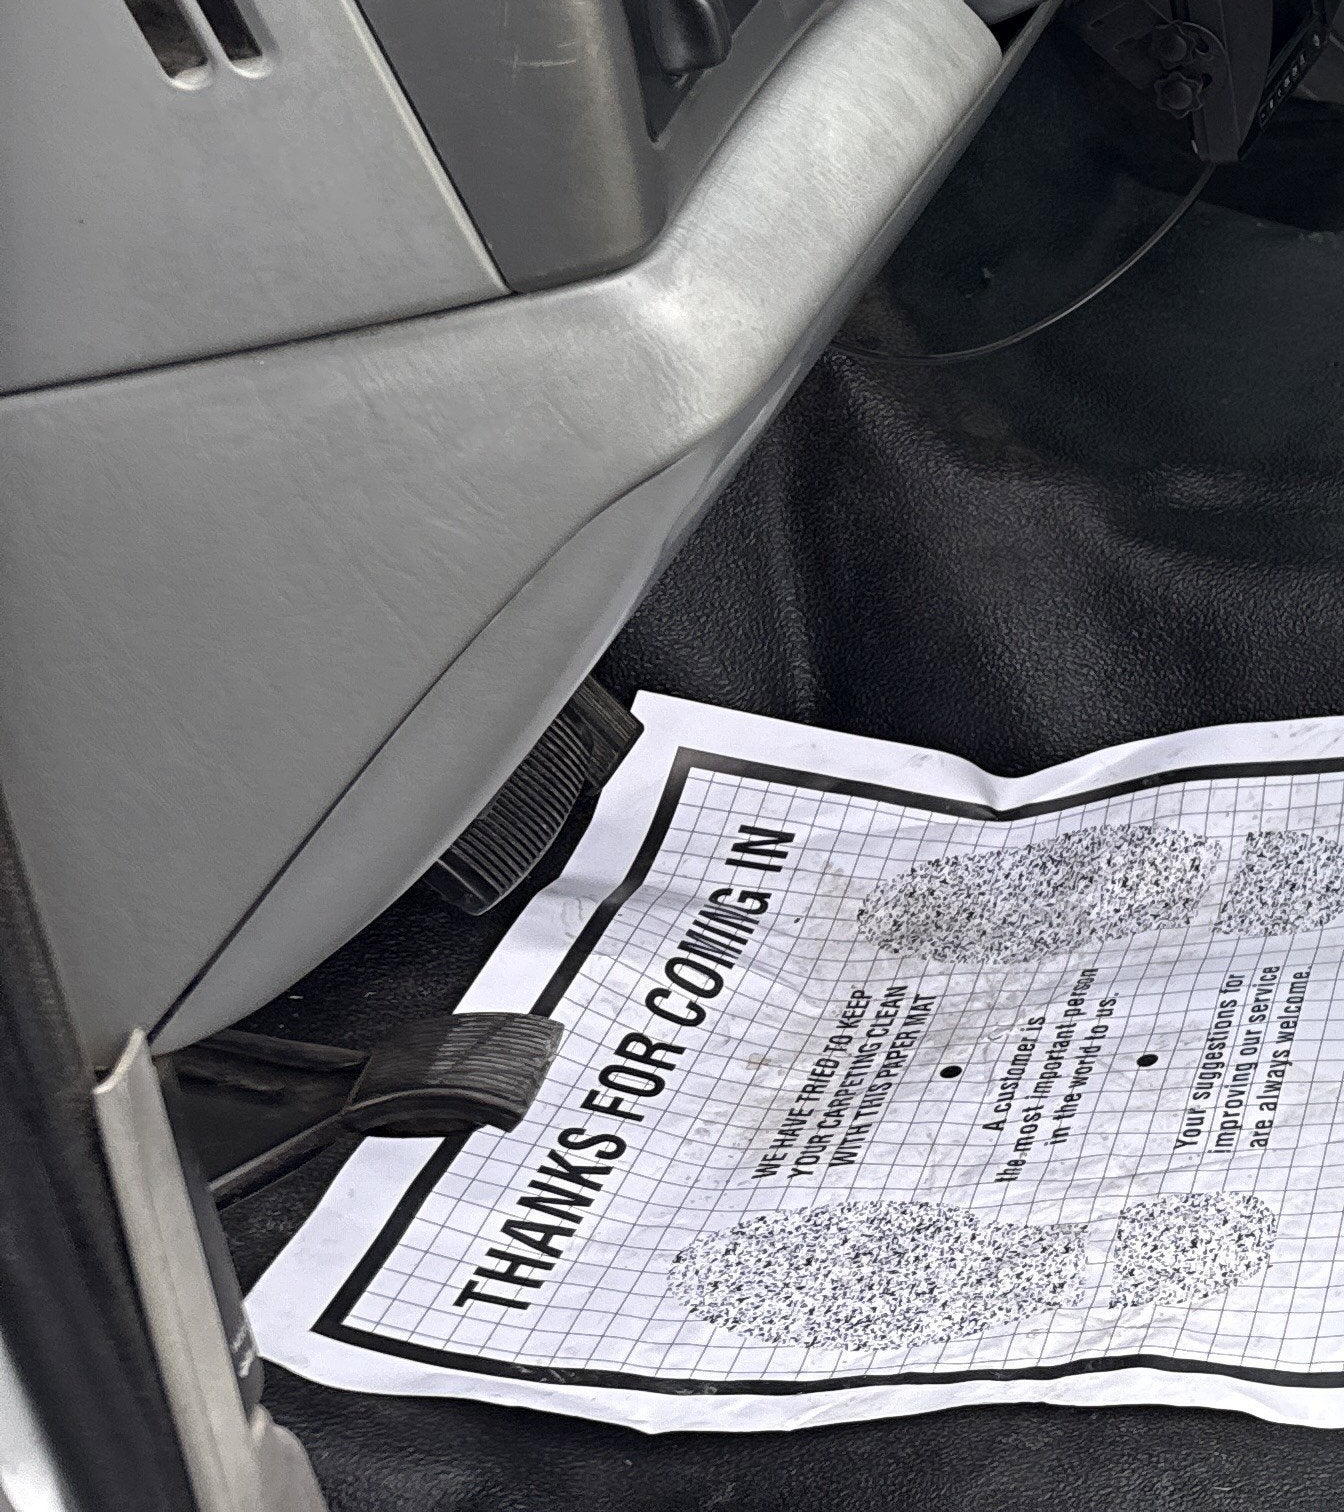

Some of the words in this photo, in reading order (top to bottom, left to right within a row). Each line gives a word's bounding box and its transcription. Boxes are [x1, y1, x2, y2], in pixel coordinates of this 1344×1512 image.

[836, 989, 873, 1030] KEEP
[1096, 991, 1121, 1020] us.
[1248, 965, 1281, 1024] service
[1275, 965, 1313, 1044] welcome.
[824, 1035, 852, 1054] TO
[1087, 1024, 1110, 1045] to
[1239, 1029, 1263, 1056] our
[453, 1127, 626, 1311] THANKS
[581, 1032, 686, 1122] FOR
[645, 888, 771, 1028] COMING
[725, 824, 796, 873] IN
[787, 1127, 833, 1180] YOUR
[817, 1041, 881, 1130] CARPETING
[866, 985, 908, 1038] CLEAN
[795, 1057, 839, 1103] TRIED
[829, 1119, 873, 1168] WITH
[854, 1082, 892, 1121] THIS
[875, 1028, 921, 1082] PAPER
[902, 993, 937, 1026] MAT
[982, 1117, 1005, 1132] A
[994, 1040, 1036, 1114] customer
[1020, 1015, 1047, 1039] is
[995, 1157, 1027, 1183] the
[1013, 1101, 1044, 1153] most
[1032, 1021, 1078, 1100] important
[1063, 967, 1099, 1020] person
[1068, 1042, 1102, 1090] world
[1173, 1107, 1207, 1150] Your
[1192, 998, 1238, 1101] suggestions
[1219, 973, 1246, 994] for
[1256, 1049, 1293, 1111] always
[769, 1107, 813, 1149] HAVE
[1052, 1089, 1082, 1123] the
[1207, 1061, 1259, 1154] improving
[1044, 1125, 1071, 1147] in
[1249, 1118, 1274, 1148] are
[751, 1152, 787, 1180] WE
